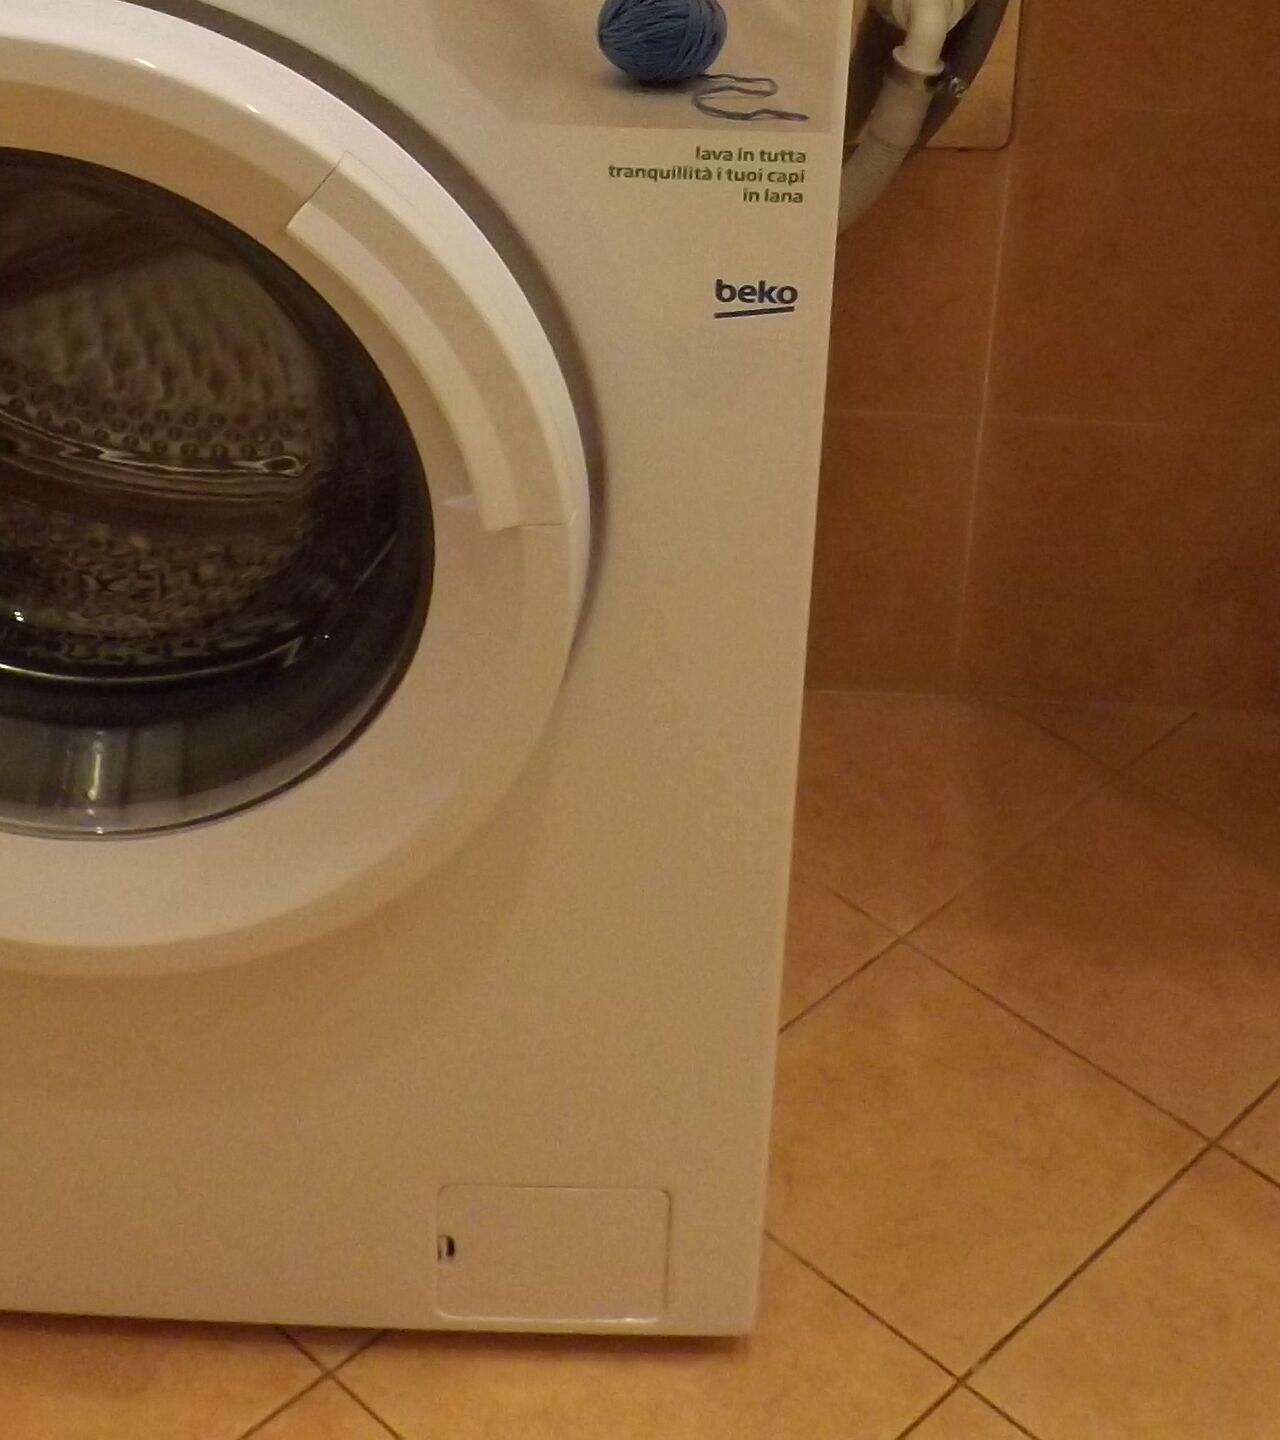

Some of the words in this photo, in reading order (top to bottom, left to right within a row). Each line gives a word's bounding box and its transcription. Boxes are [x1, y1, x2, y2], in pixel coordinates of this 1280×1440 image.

[696, 146, 733, 161] lava
[737, 147, 755, 162] in
[759, 148, 807, 163] tutta
[608, 164, 712, 182] tranquillità
[726, 167, 763, 182] tuoi
[767, 169, 805, 186] capi
[742, 187, 761, 202] in
[764, 188, 804, 203] lana
[715, 278, 798, 304] beko
